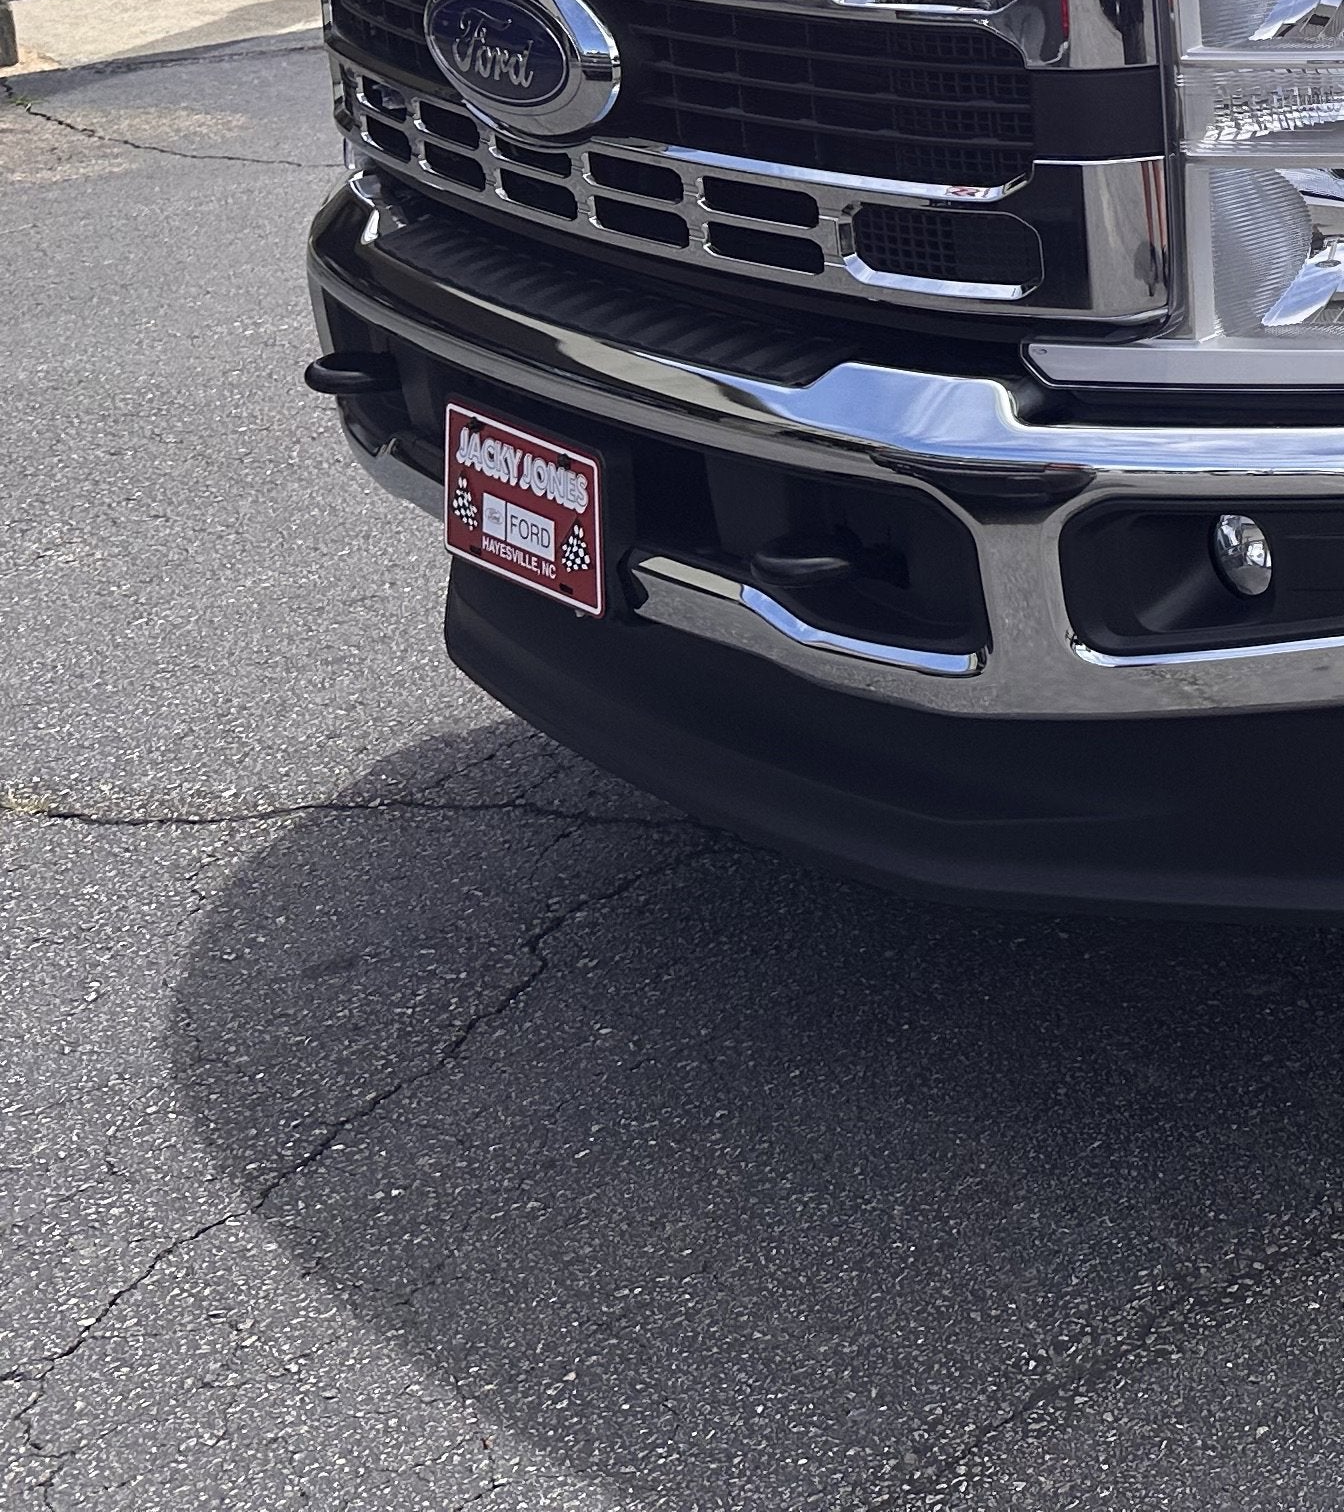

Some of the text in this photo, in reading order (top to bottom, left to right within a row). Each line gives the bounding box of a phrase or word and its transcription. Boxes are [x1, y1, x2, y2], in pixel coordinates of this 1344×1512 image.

[453, 6, 535, 88] Ford
[456, 426, 589, 514] JACKY JONES
[482, 536, 557, 579] HAYESVILLE, NC
[510, 514, 551, 549] FORD
